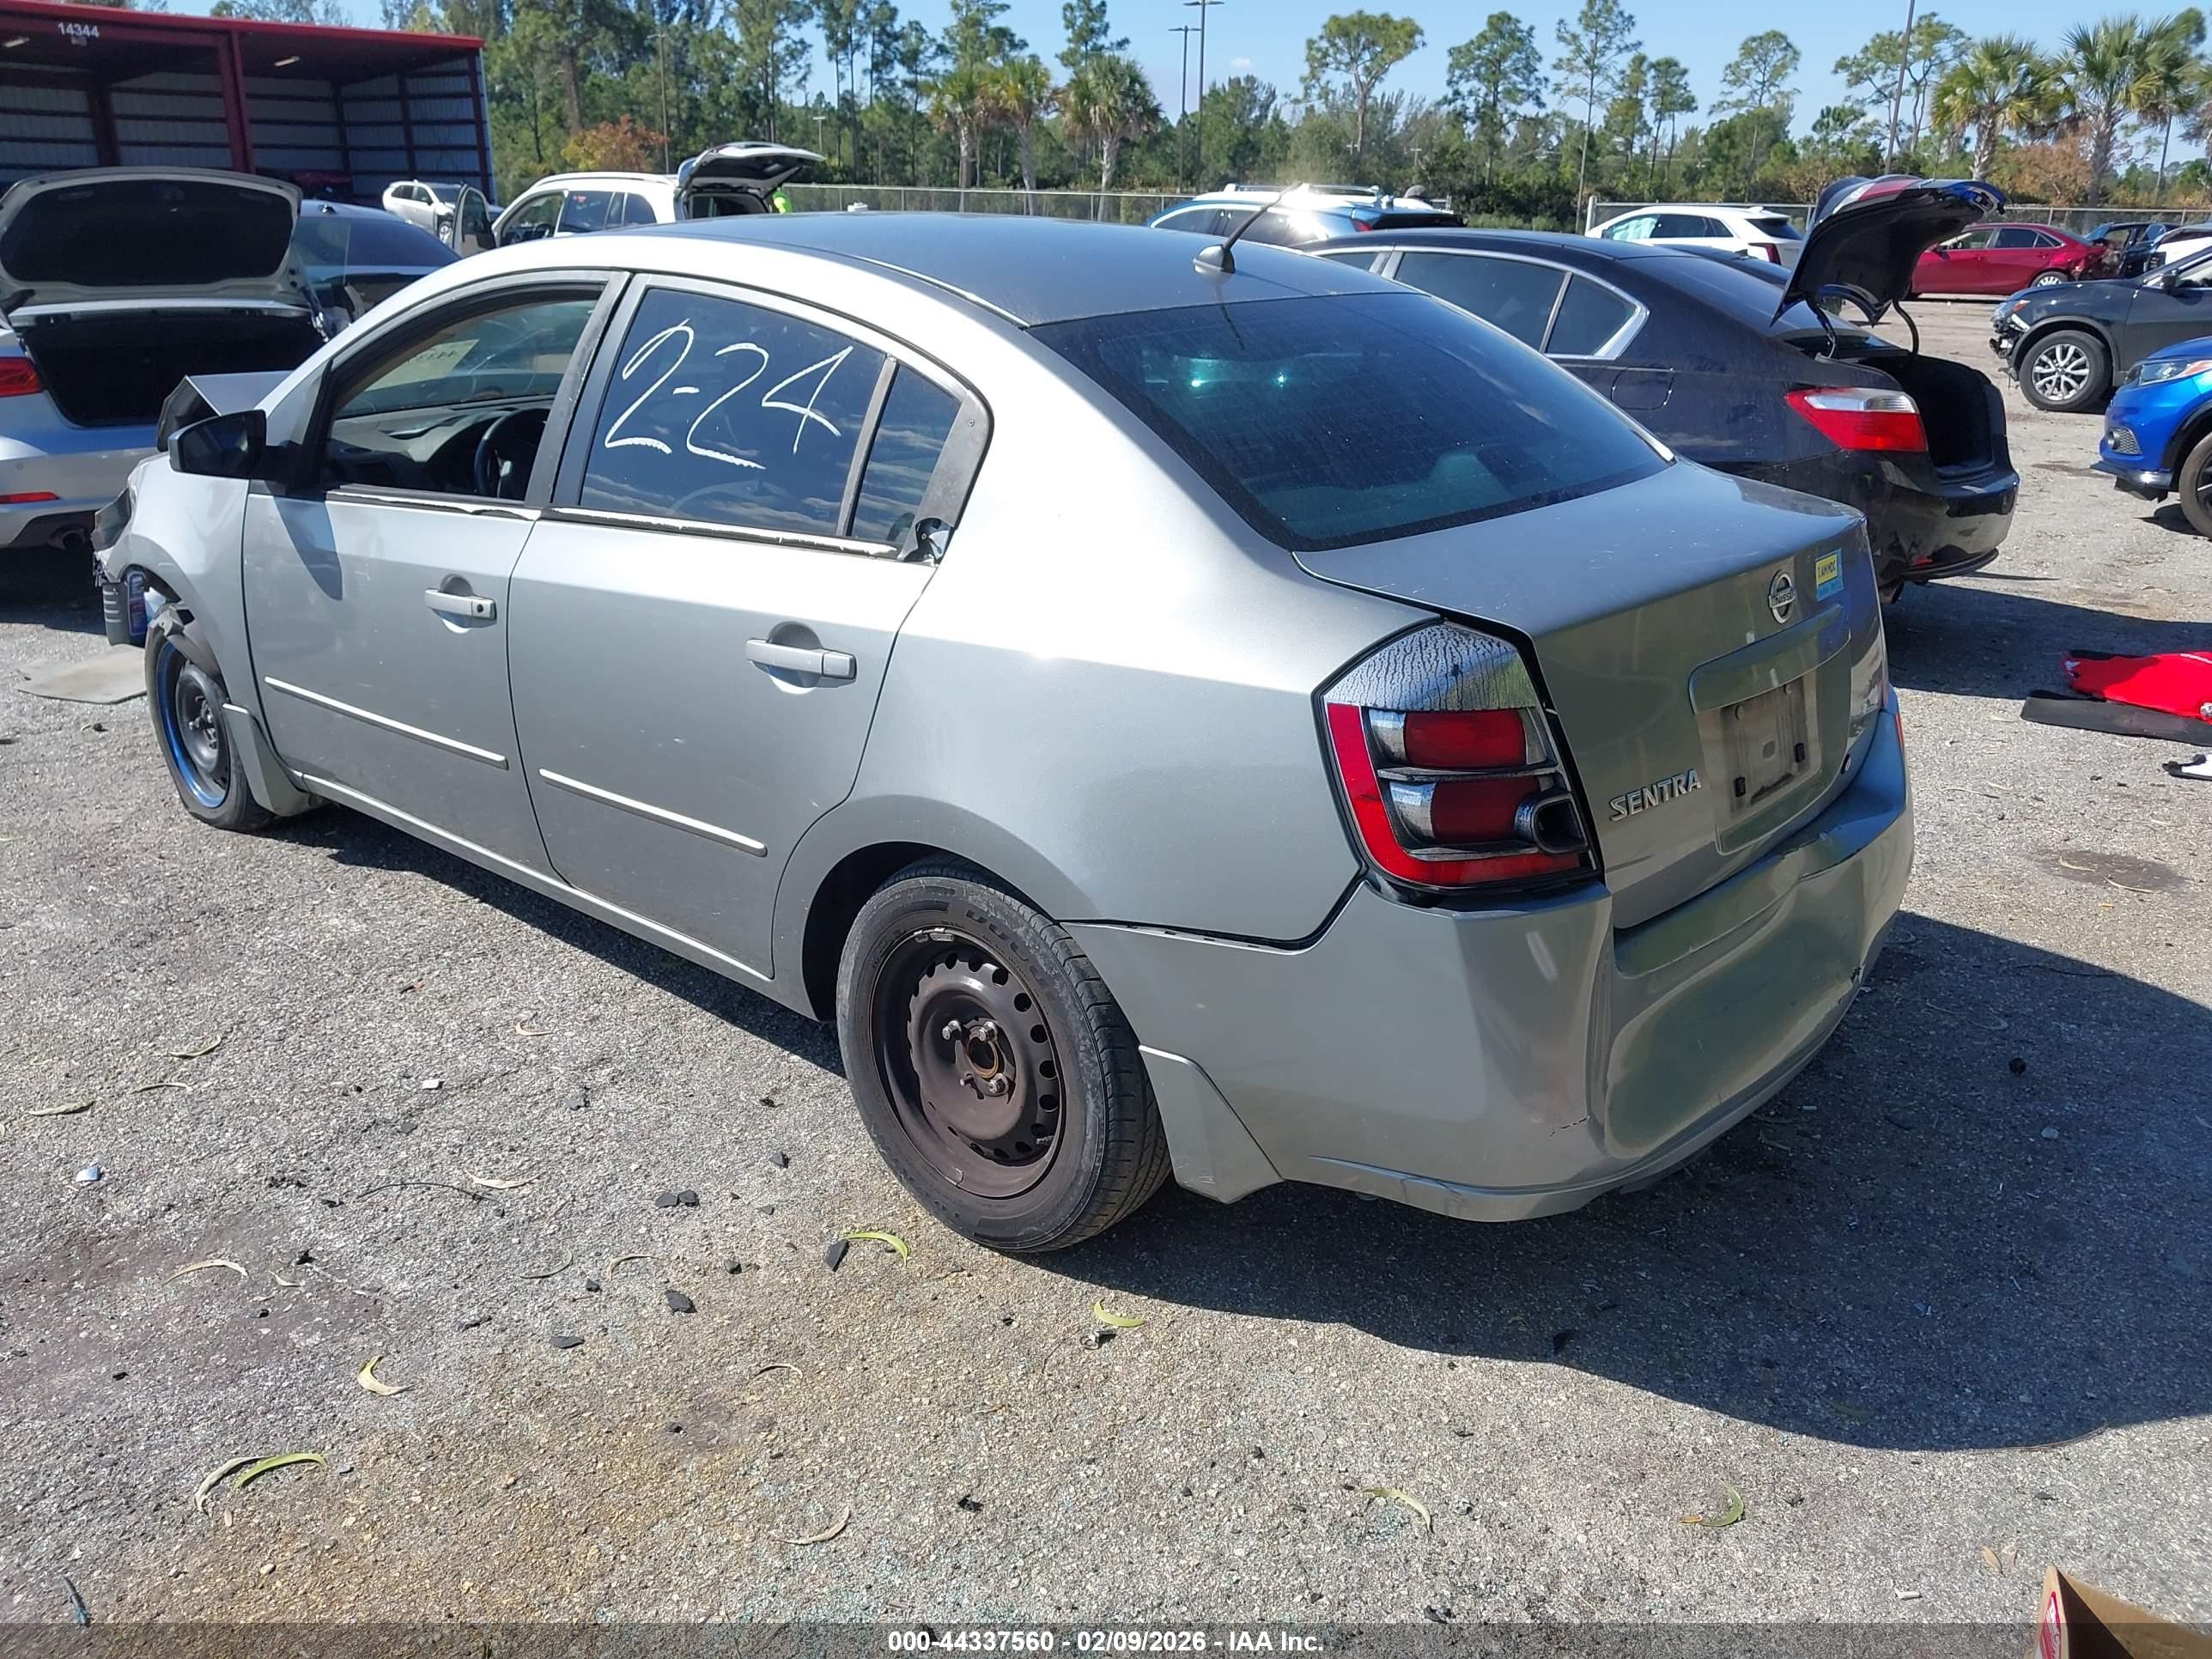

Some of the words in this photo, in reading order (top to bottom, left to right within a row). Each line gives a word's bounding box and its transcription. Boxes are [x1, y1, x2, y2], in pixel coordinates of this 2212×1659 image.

[58, 21, 100, 38] 14344
[605, 318, 854, 470] 2-24
[1609, 769, 1702, 822] SENTRA
